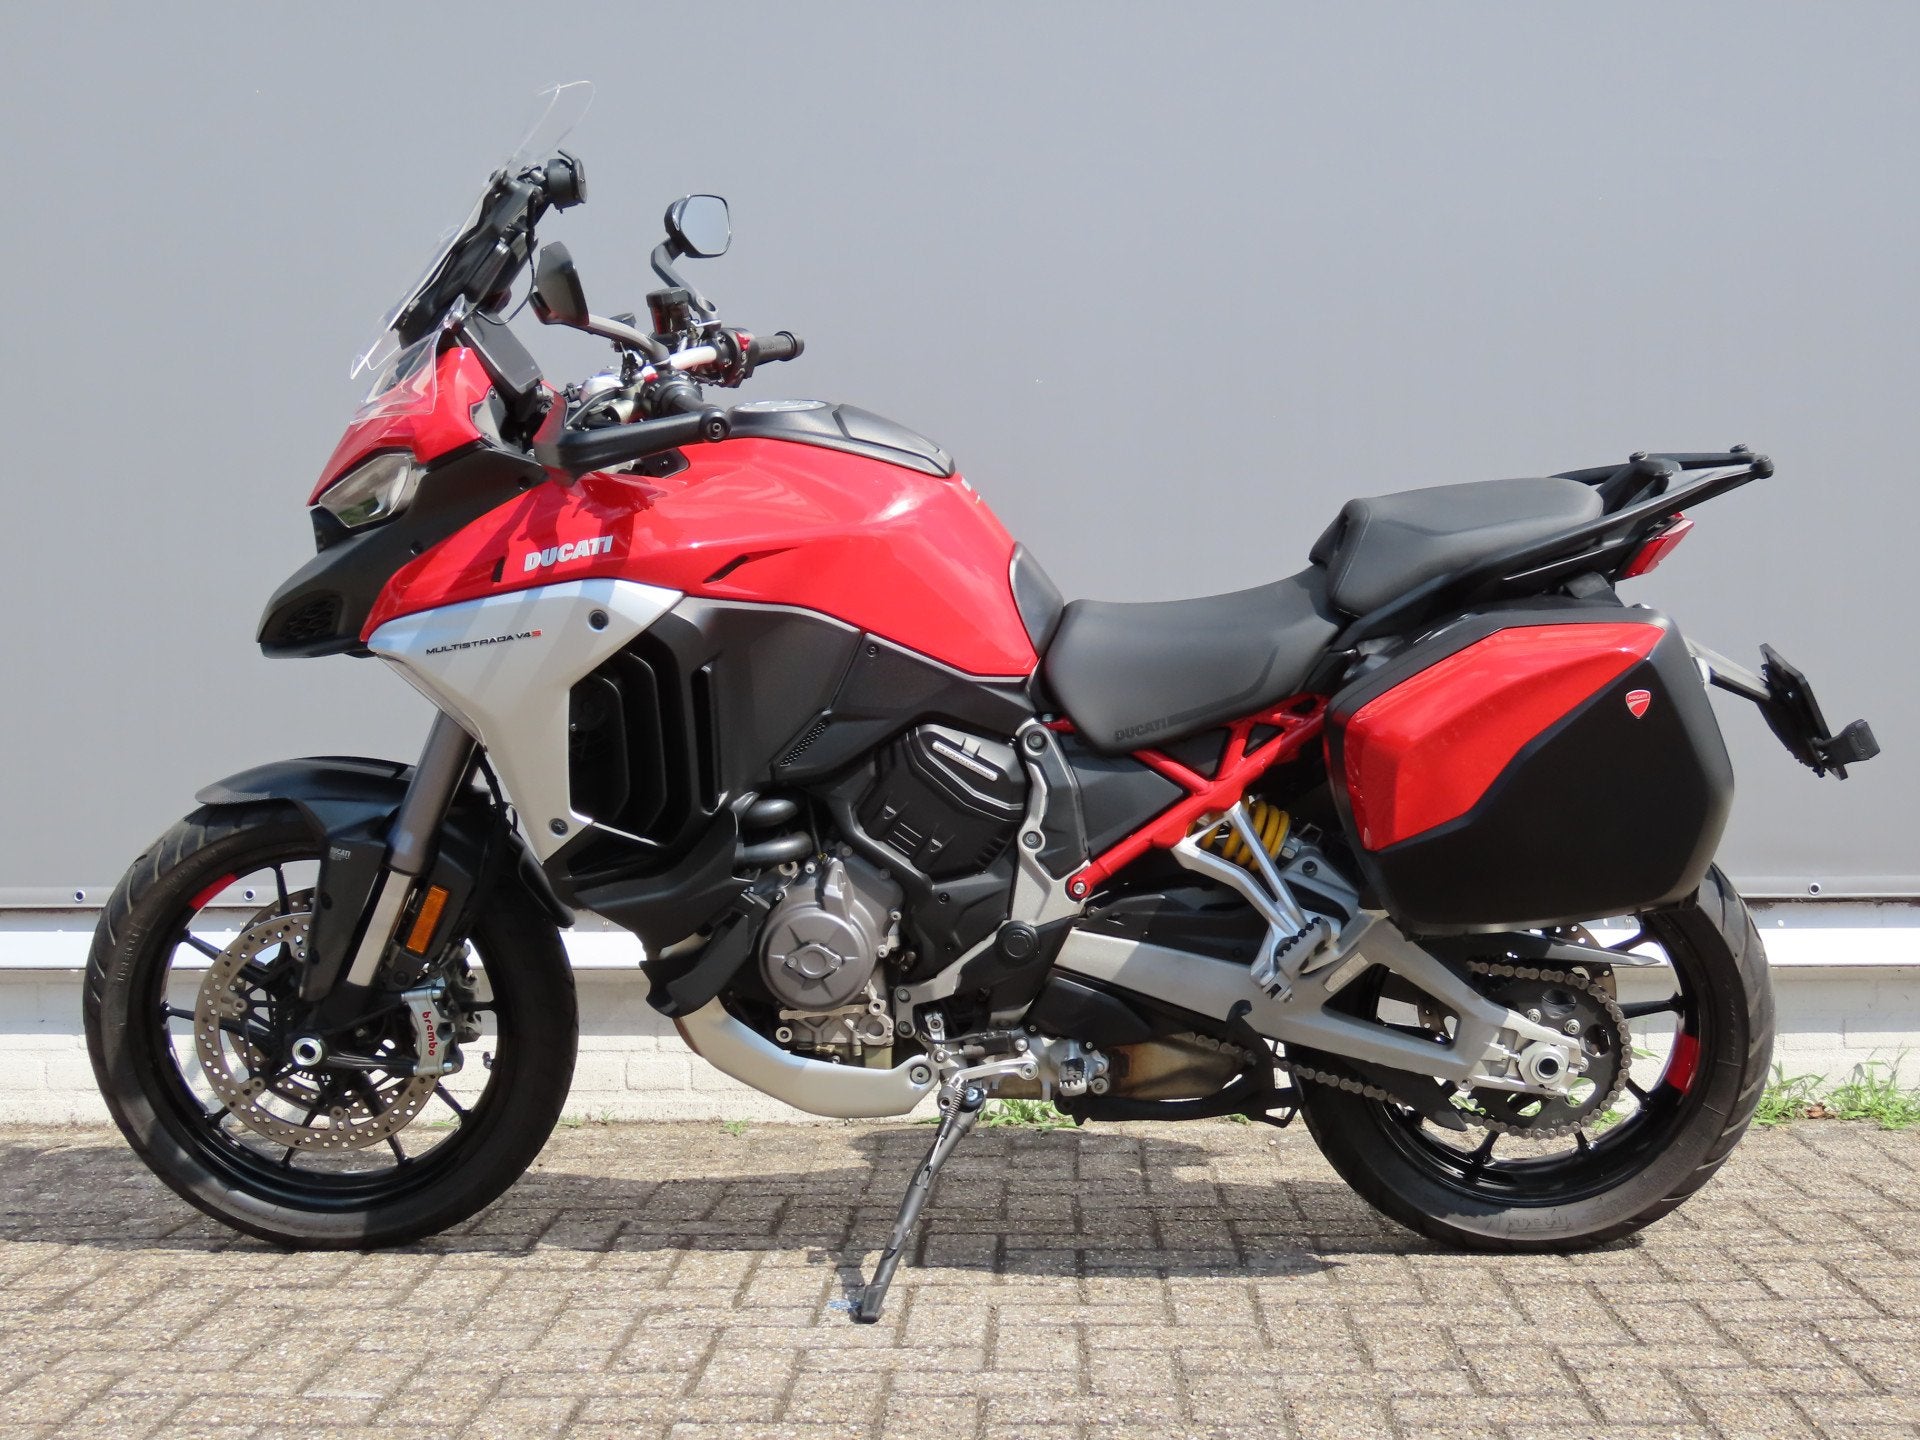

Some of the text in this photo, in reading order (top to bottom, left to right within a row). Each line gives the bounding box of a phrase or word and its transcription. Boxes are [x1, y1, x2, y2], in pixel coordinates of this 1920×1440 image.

[523, 534, 614, 572] DUCATI
[425, 629, 542, 655] MULTISTRADA V4S
[1114, 717, 1168, 741] DUCATI
[422, 1011, 438, 1056] brembo
